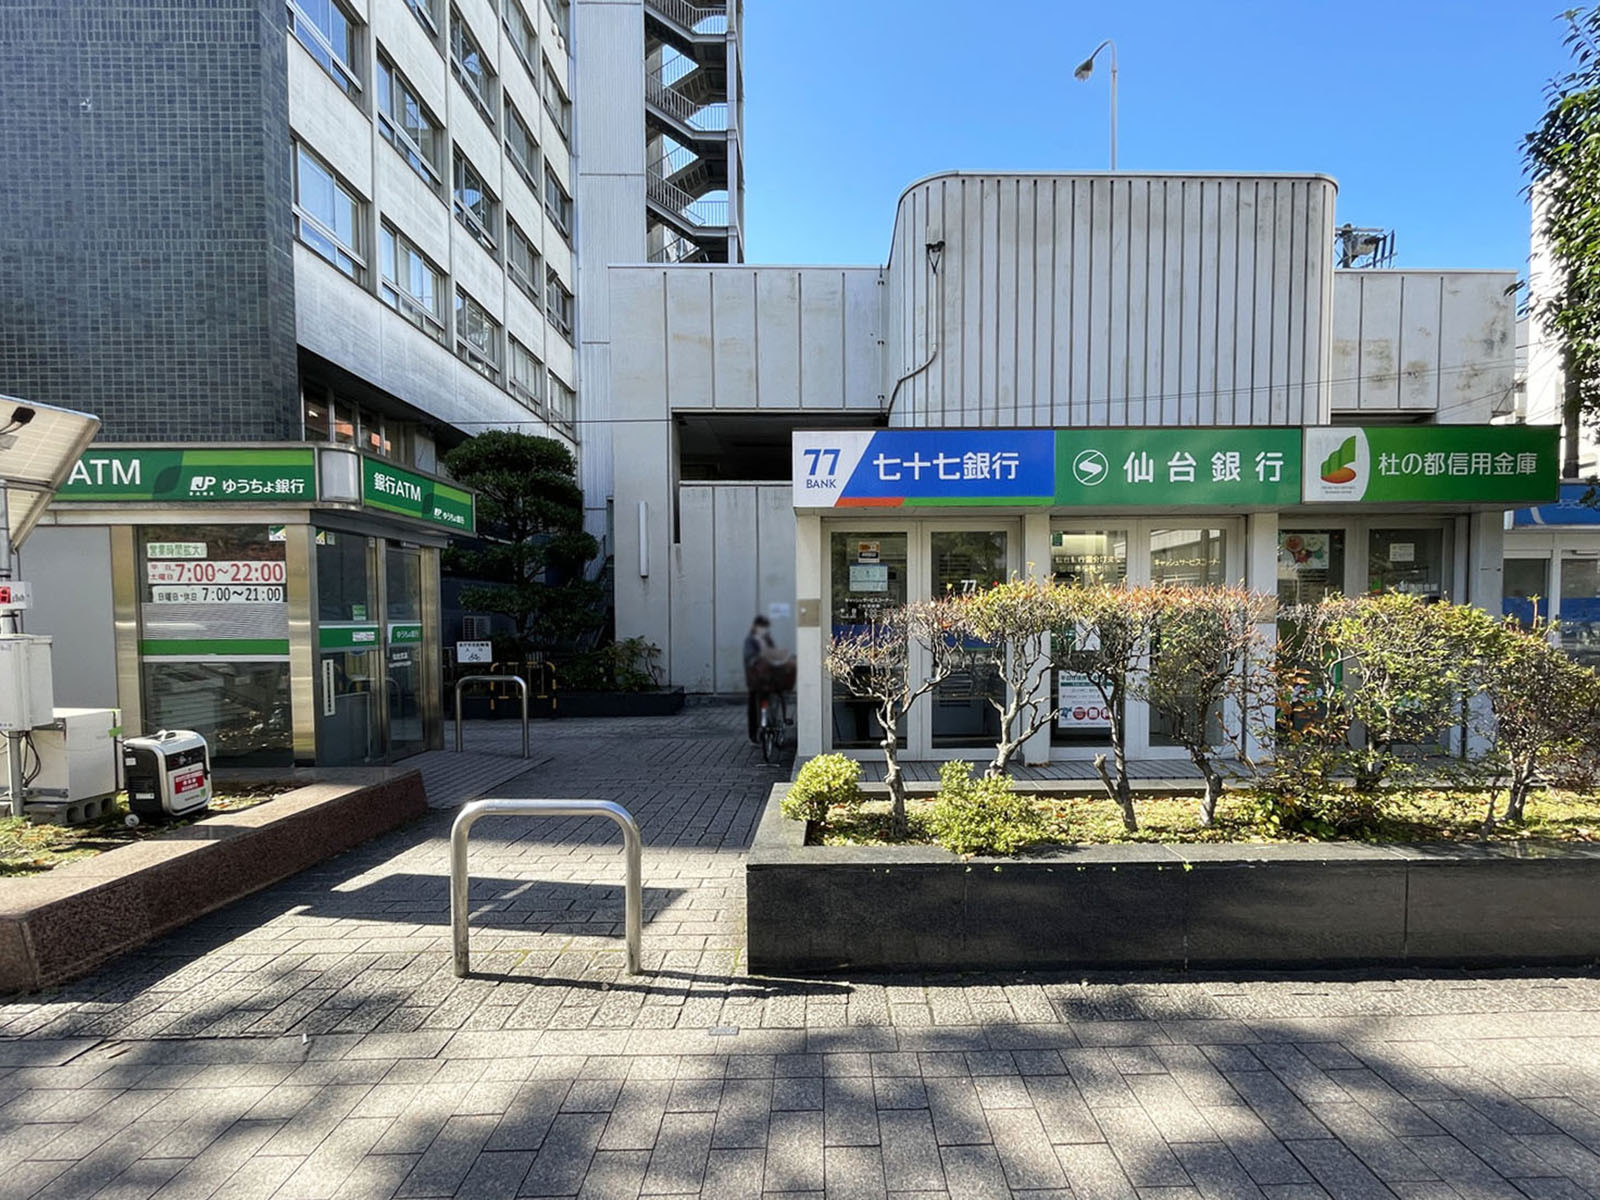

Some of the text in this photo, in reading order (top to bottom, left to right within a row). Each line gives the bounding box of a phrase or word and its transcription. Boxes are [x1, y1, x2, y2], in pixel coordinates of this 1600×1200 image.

[67, 459, 141, 485] ATM
[803, 449, 841, 476] 77
[873, 452, 1020, 481] 七十七銀行
[1123, 451, 1285, 483] 仙台銀行
[1378, 452, 1538, 476] 杜の都信用金庫
[190, 476, 216, 491] JP
[222, 478, 305, 494] ゆうちょ銀行
[374, 472, 422, 502] 銀行ATM
[806, 479, 837, 489] BANK
